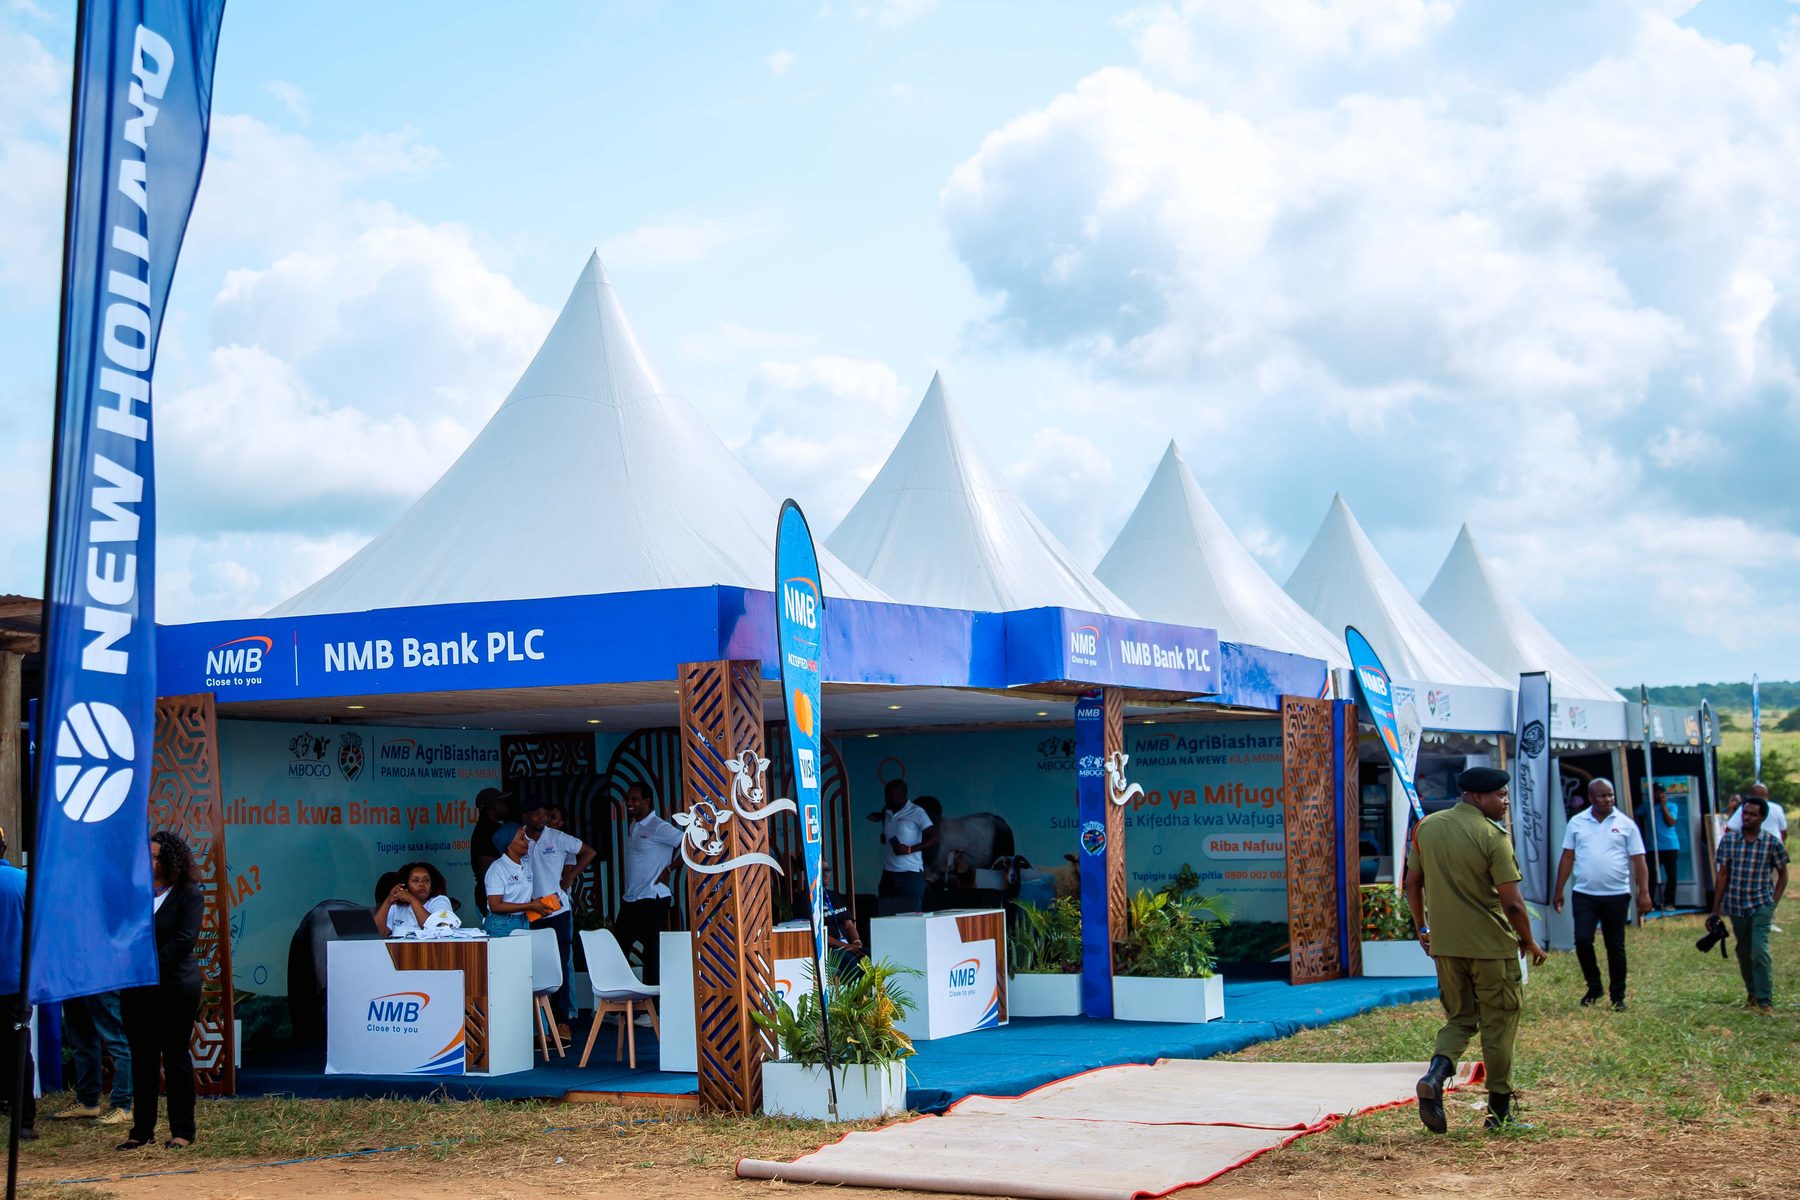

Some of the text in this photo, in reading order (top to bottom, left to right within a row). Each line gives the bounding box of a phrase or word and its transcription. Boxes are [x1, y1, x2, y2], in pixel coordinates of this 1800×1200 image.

[82, 453, 144, 675] NEW
[784, 582, 816, 629] NMB
[324, 628, 545, 672] NMB Bank PLC
[1071, 632, 1096, 656] NMB
[206, 648, 263, 675] NMB
[1120, 640, 1211, 672] NMB Bank PLC
[206, 677, 262, 687] Close to you
[1359, 667, 1387, 696] NMB
[1077, 709, 1100, 717] NMB
[380, 743, 500, 764] NMB AgriBiashara
[1135, 735, 1283, 754] NMB AgriBiashara
[288, 764, 331, 777] MBOGO
[1136, 756, 1177, 767] PAMOJA
[1179, 755, 1193, 766] NA
[1195, 755, 1227, 765] WEWE
[1228, 754, 1249, 764] KILA
[381, 766, 416, 779] PAMOJA
[417, 767, 430, 778] NA
[431, 768, 456, 779] WEWE
[1168, 789, 1197, 809] ya
[297, 799, 342, 825] kwa
[350, 799, 400, 825] Bima
[406, 806, 430, 831] ya
[436, 799, 479, 829] Mifu
[1050, 816, 1080, 829] Sulu
[1136, 813, 1190, 831] Kifedha
[1194, 812, 1224, 826] kwa
[1226, 811, 1284, 829] Wafuga
[376, 840, 470, 854] Tupigie sasa kupitia 0800
[1209, 840, 1284, 854] Riba Nafuu
[1133, 871, 1166, 881] Tupigie
[1224, 871, 1248, 880] 0800
[1250, 871, 1267, 880] 002
[949, 968, 975, 988] NMB
[949, 990, 962, 998] Close
[367, 1001, 420, 1023] NMB
[367, 1025, 418, 1034] Close to you
